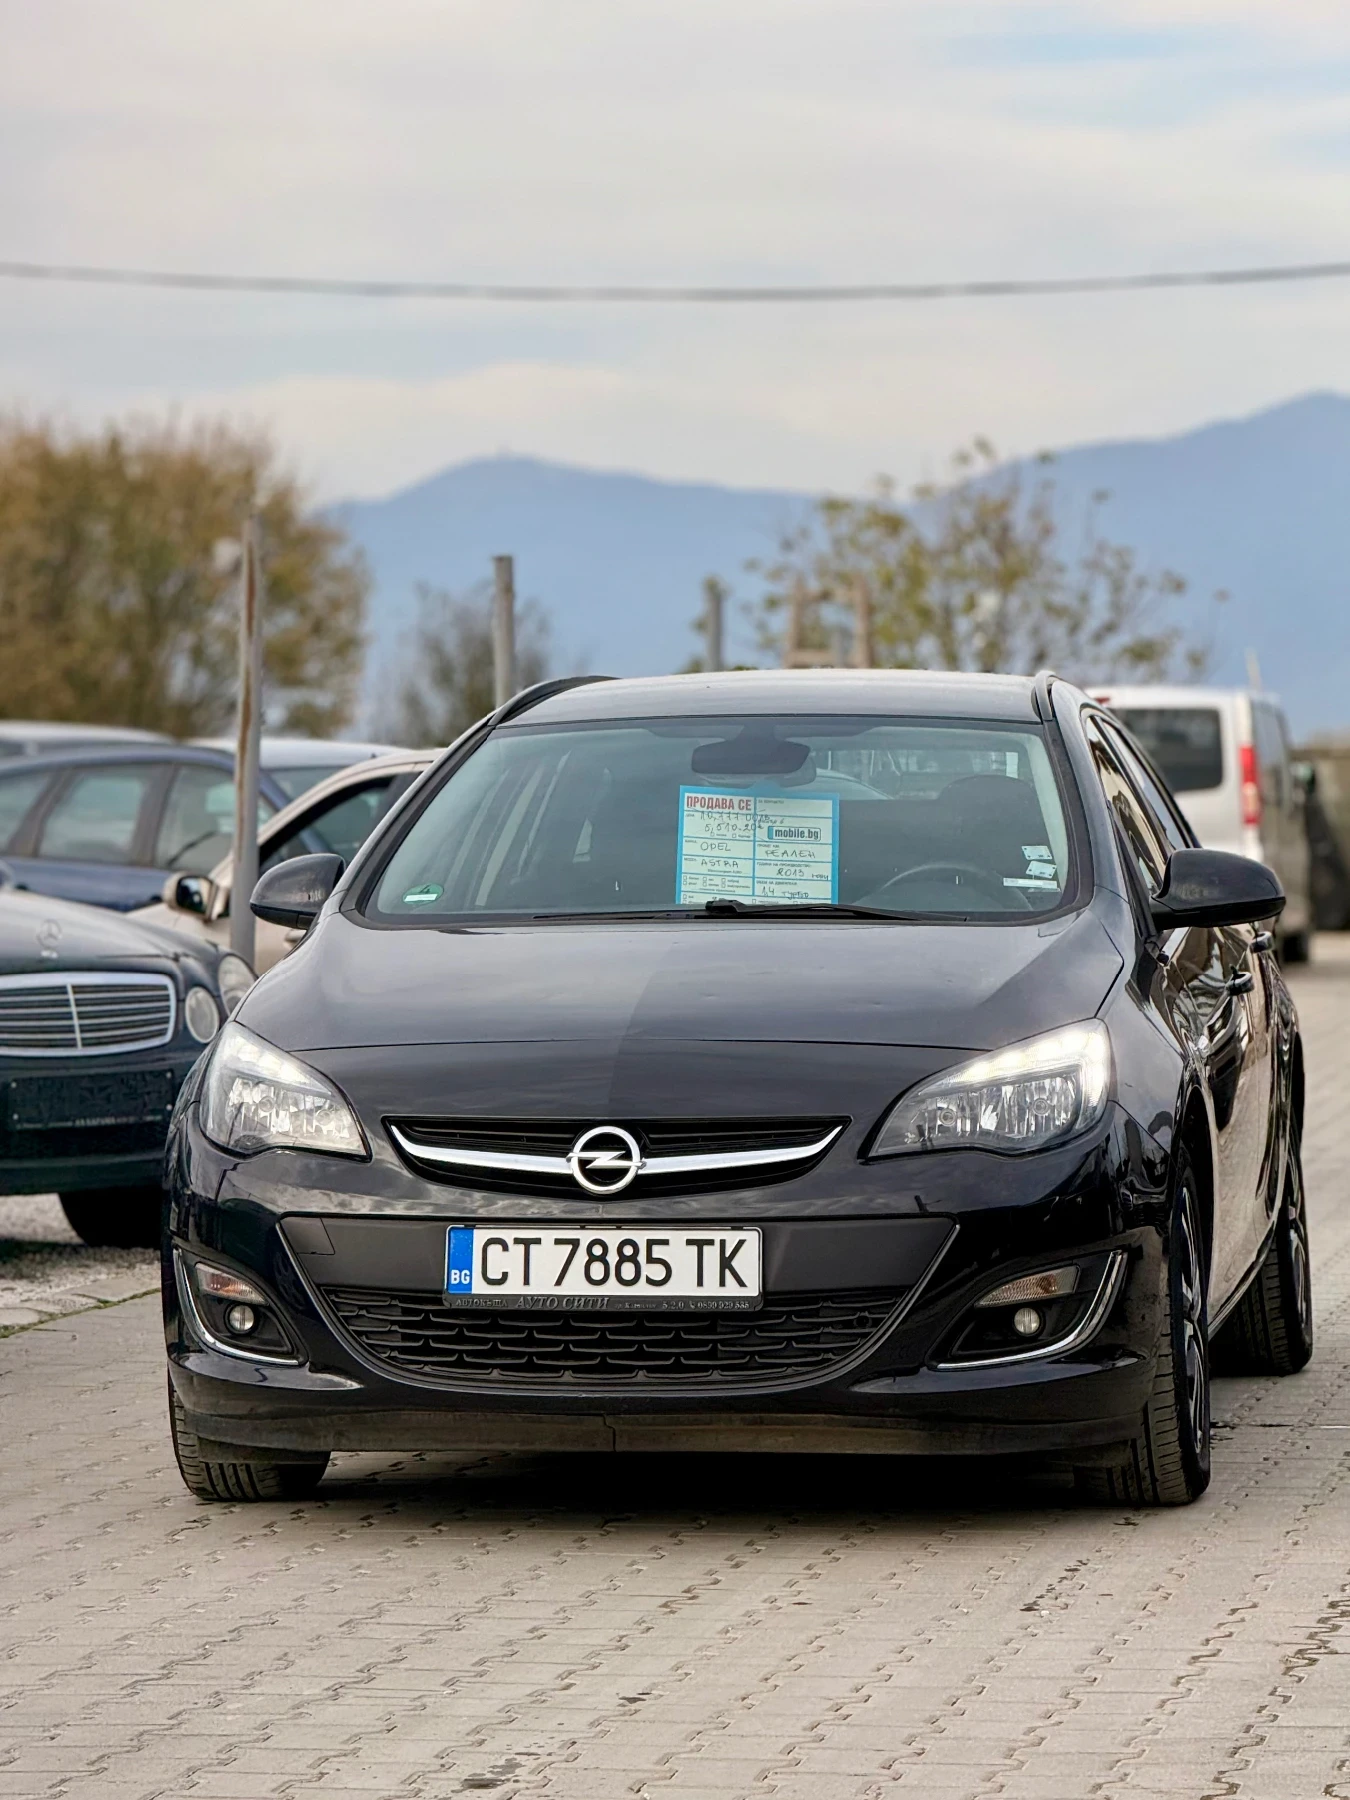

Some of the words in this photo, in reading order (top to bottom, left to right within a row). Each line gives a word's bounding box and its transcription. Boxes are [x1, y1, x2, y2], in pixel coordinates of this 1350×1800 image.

[686, 795, 735, 810] ПРОДАВА
[738, 799, 752, 811] СЕ
[775, 828, 819, 840] mobile.bg
[700, 841, 731, 852] OPEL
[701, 858, 739, 868] ASTRA
[776, 867, 805, 877] 2013
[553, 1238, 673, 1287] 7885
[451, 1270, 470, 1284] BG
